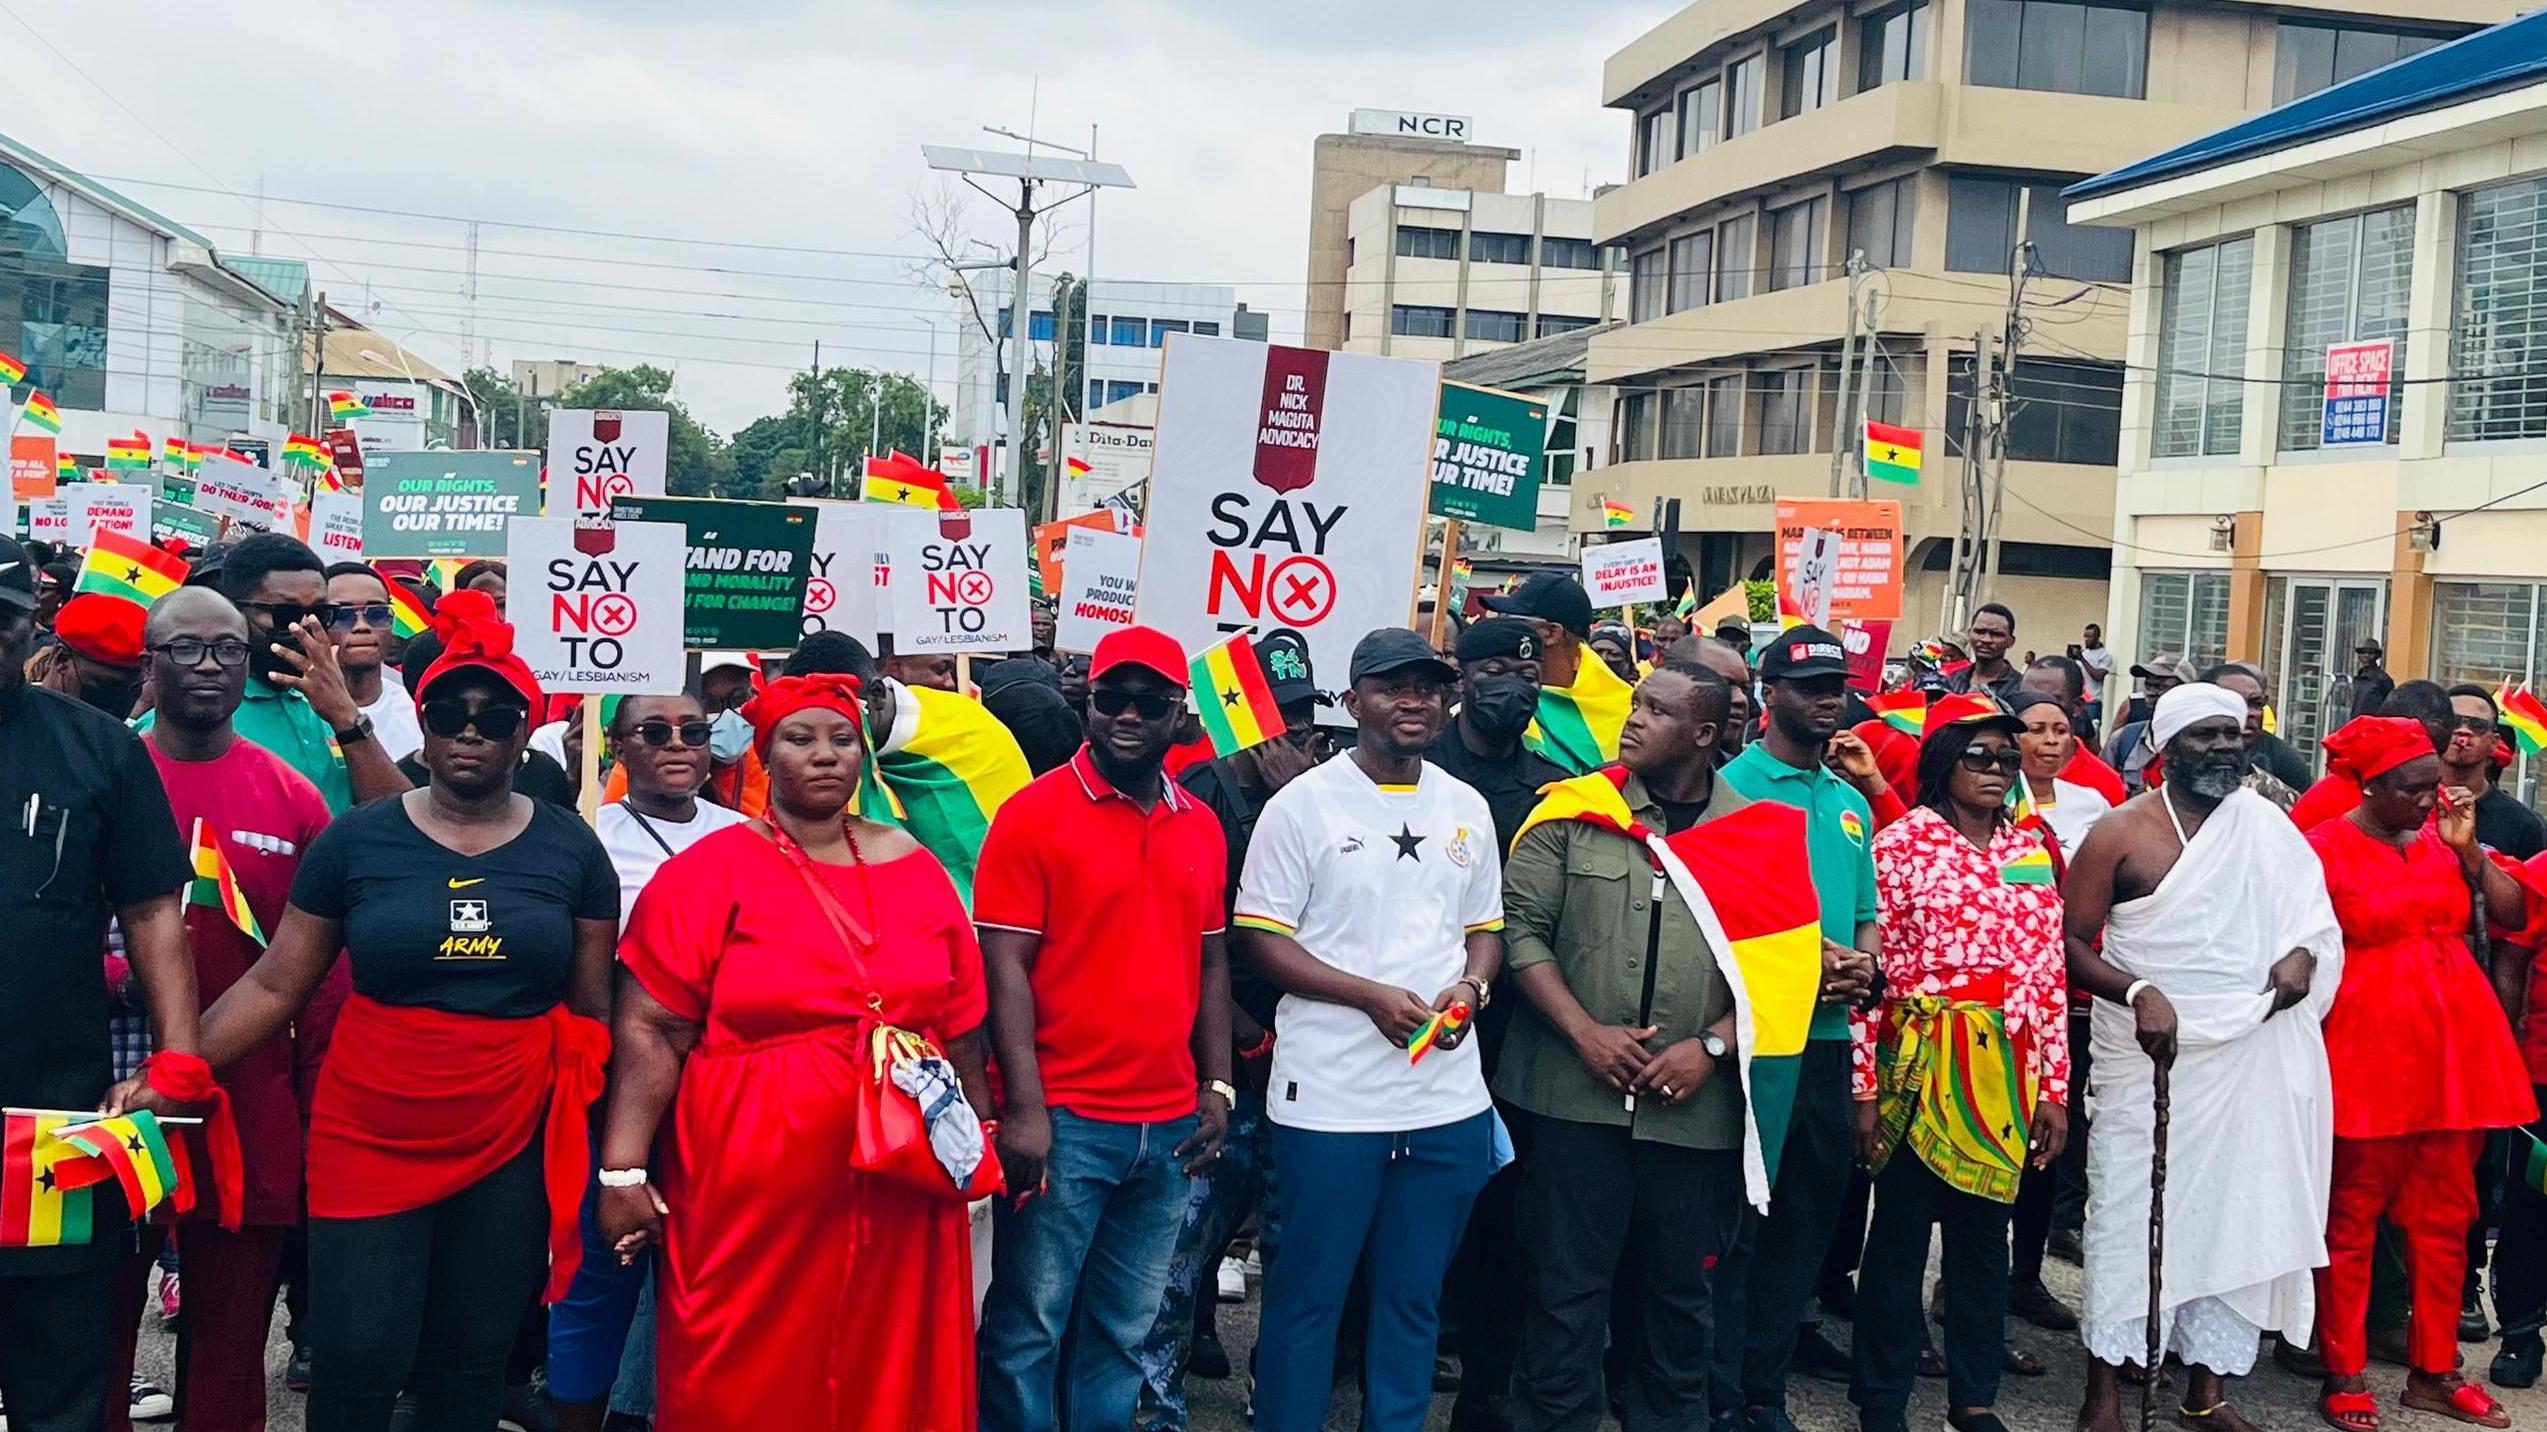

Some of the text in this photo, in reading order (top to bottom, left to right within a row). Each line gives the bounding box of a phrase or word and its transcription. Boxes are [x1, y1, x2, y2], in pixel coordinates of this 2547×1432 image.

[1399, 116, 1464, 137] NCR
[2330, 349, 2387, 375] OFFICE SPACE
[1285, 375, 1304, 392] DR.
[1280, 393, 1307, 411] NICK
[1268, 411, 1315, 430] MAGUTA
[1258, 428, 1319, 449] ADVOCACY
[574, 447, 637, 474] SAY
[1451, 443, 1530, 477] JUSTICE
[398, 480, 497, 494] OUR RIGHTS,
[1461, 467, 1515, 497] TIME!
[201, 484, 216, 495] DO
[218, 488, 249, 504] THEIR
[380, 495, 520, 513] OUR JUSTICE
[35, 517, 51, 526] NO
[87, 507, 133, 517] DEMAND
[393, 514, 505, 531] OUR TIME!
[1206, 493, 1348, 555] SAY
[323, 531, 363, 551] LISTEN
[1848, 528, 1892, 540] BETWEEN
[685, 546, 741, 571] TAND
[744, 550, 793, 573] FOR
[921, 544, 992, 571] SAY
[547, 559, 639, 592] SAY
[1100, 574, 1123, 589] YOU
[1595, 563, 1657, 580] DELAY IS AN
[1803, 561, 1827, 584] SAY
[714, 575, 795, 592] MORALITY
[928, 570, 993, 605] NO
[1206, 550, 1336, 627] NO
[1600, 575, 1657, 592] INJUSTICE!
[693, 595, 725, 609] FOR
[728, 596, 796, 612] CHANGE!
[1085, 588, 1135, 606] PRODUC
[552, 593, 637, 636] NO
[936, 607, 985, 633] TO
[560, 637, 623, 669] TO
[439, 936, 503, 957] ARMY
